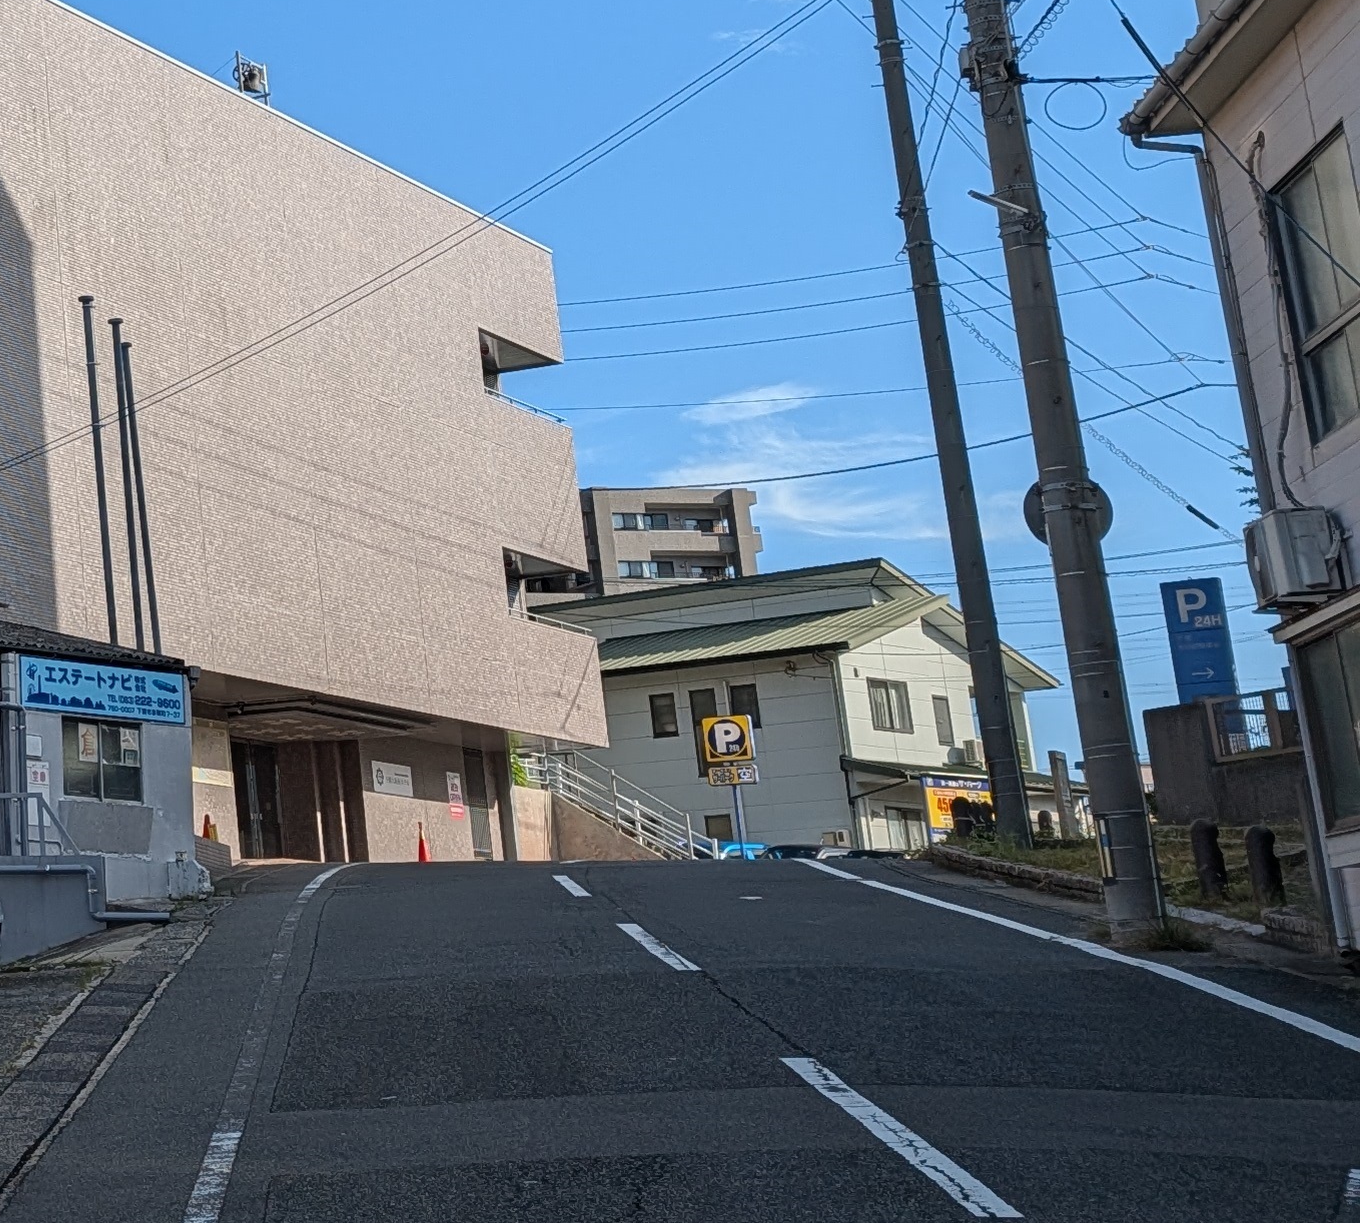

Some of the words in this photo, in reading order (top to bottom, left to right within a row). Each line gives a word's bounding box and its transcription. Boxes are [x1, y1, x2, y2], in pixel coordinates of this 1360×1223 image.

[1176, 588, 1207, 623] P
[1194, 614, 1222, 628] 24H
[45, 666, 133, 693] エステートナビ
[714, 722, 741, 753] P
